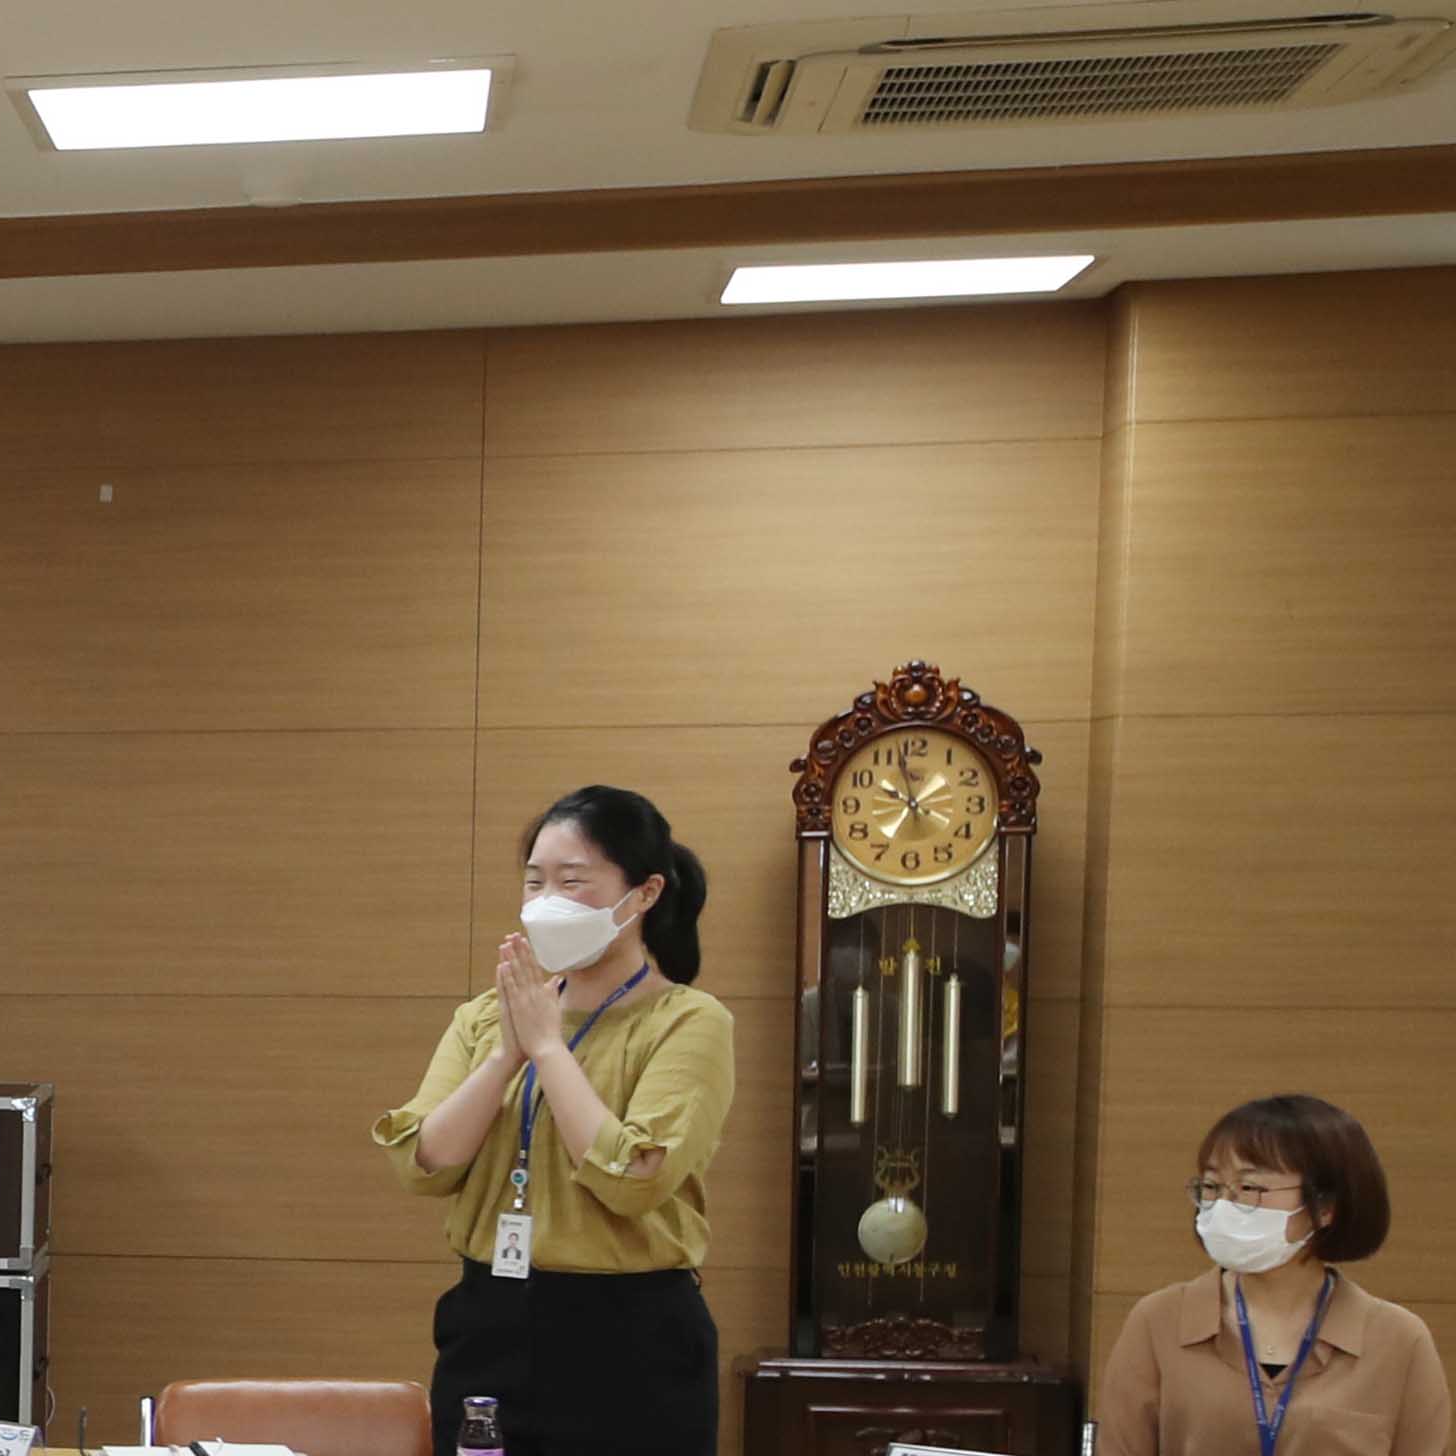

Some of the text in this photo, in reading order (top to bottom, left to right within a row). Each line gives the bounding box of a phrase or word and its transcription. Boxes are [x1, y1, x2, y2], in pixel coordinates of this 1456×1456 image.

[873, 747, 953, 766] 11 1
[903, 739, 928, 757] 12
[851, 769, 979, 788] 10 2
[842, 796, 985, 815] 9 3
[848, 822, 972, 841] 8 4
[871, 844, 953, 863] 7 5
[901, 852, 920, 870] 6
